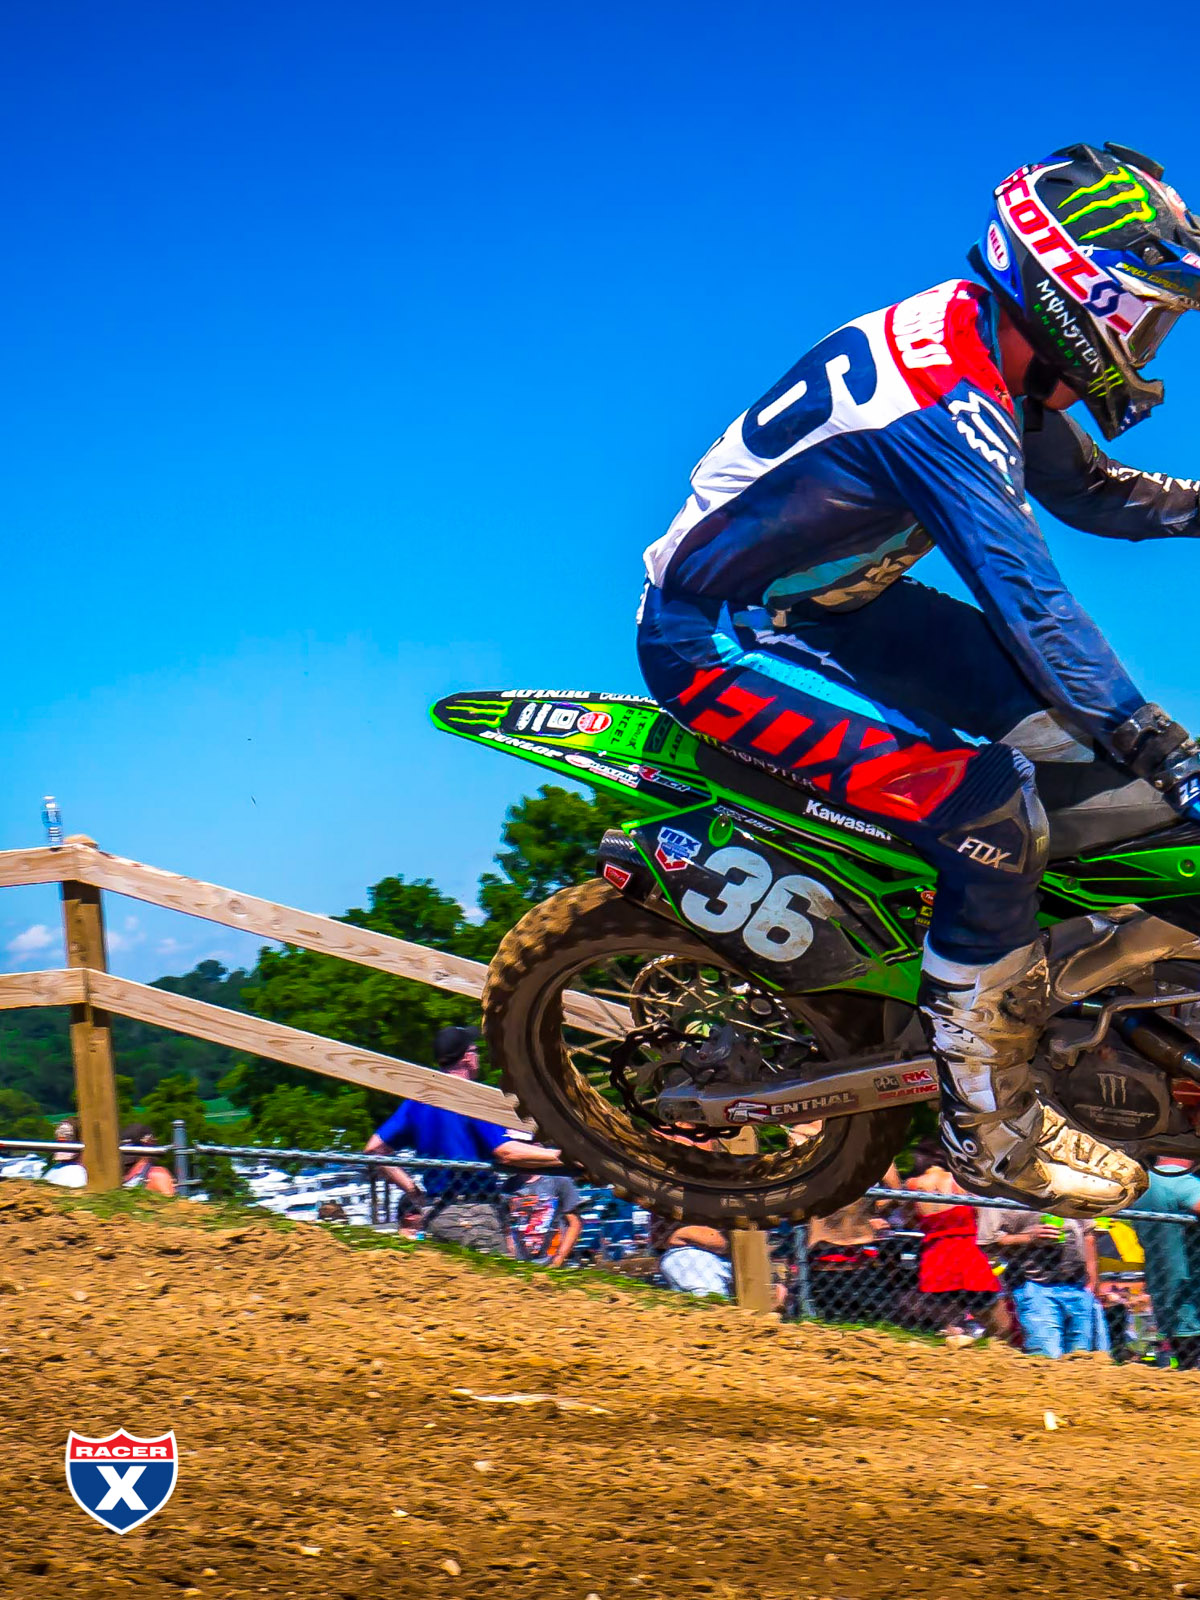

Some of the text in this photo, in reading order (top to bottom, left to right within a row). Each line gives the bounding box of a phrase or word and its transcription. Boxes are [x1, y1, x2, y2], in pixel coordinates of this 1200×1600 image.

[989, 227, 1008, 265] BELL
[1036, 278, 1100, 373] MONSTER
[742, 326, 878, 460] 6
[479, 730, 564, 758] DUNLOP
[611, 708, 635, 745] EXCEL
[957, 836, 1011, 869] FOX
[681, 846, 834, 963] 36
[902, 1069, 933, 1083] RK
